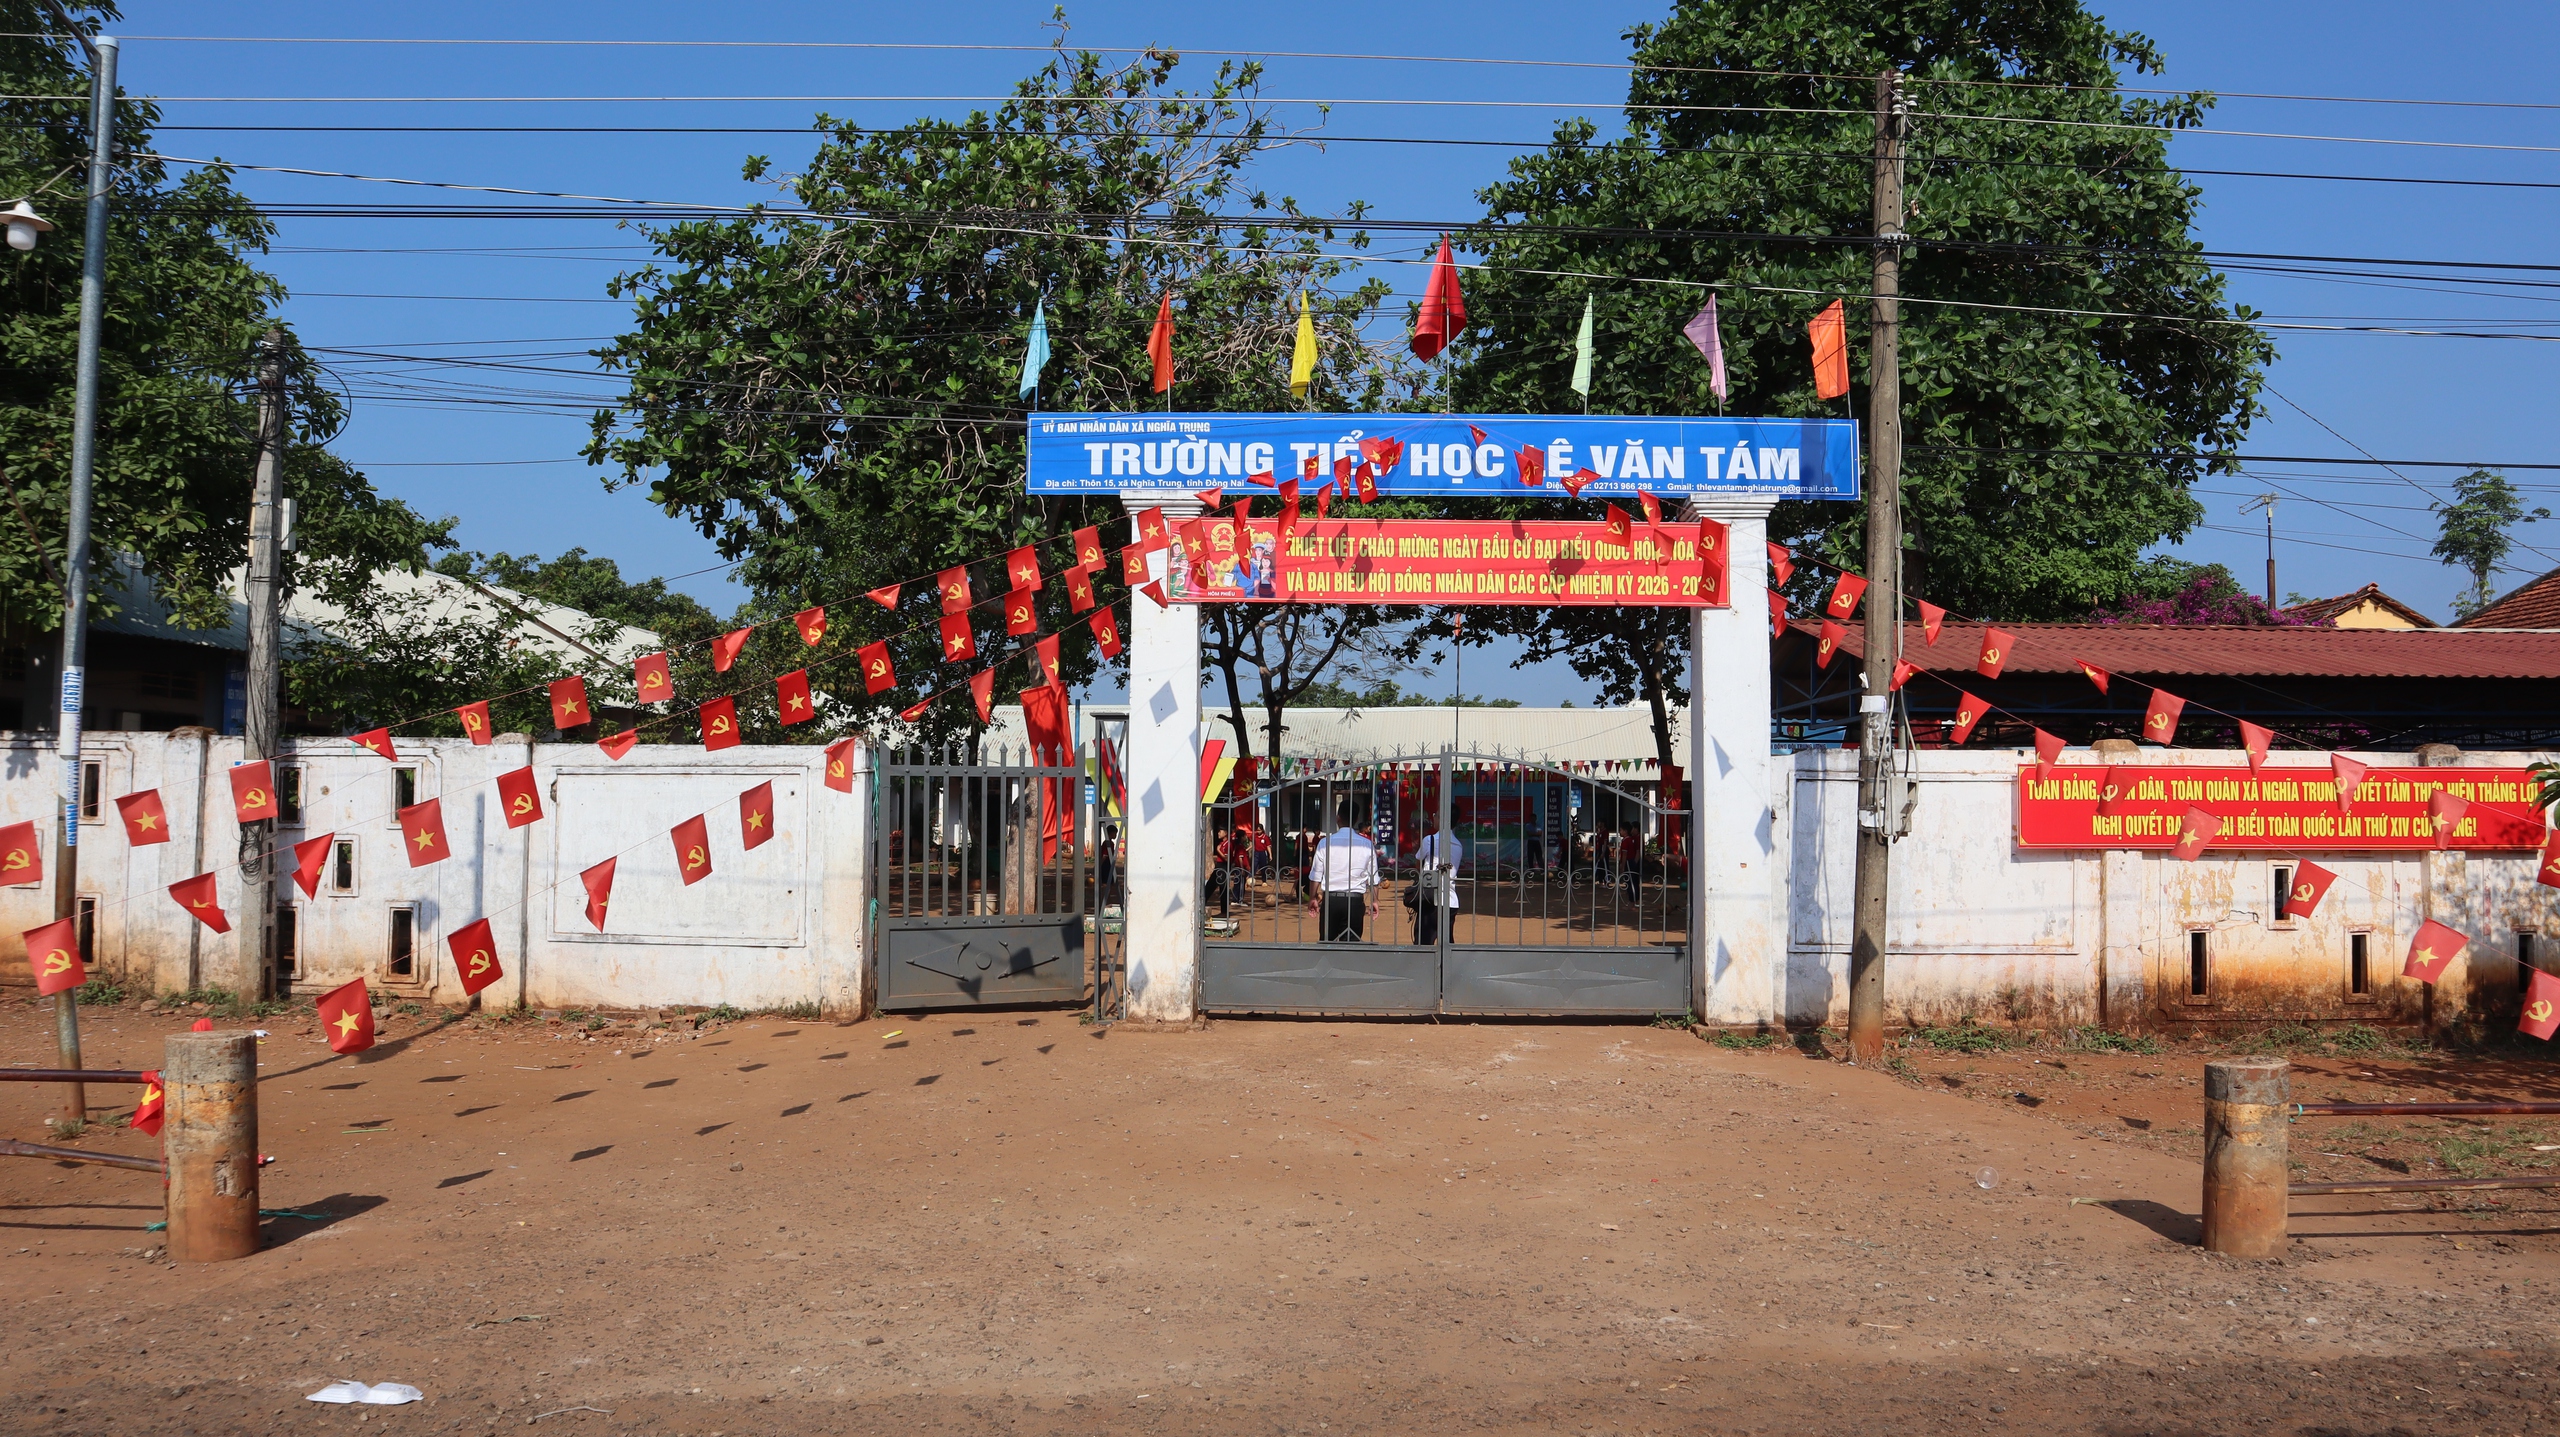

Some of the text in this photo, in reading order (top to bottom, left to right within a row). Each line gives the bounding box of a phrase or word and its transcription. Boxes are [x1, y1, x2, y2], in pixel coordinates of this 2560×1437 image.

[1057, 422, 1077, 432] BAN
[1080, 420, 1106, 432] NHÂN
[1109, 420, 1129, 432] DÂN
[1131, 420, 1144, 432] XÃ
[1147, 420, 1176, 432] NGHĨA
[1179, 422, 1210, 432] TRUNG
[1084, 429, 1799, 484] TRƯỜNG TIỂ HỌC Ê VĂN TÁM
[1045, 480, 1059, 488] Địa
[1062, 479, 1077, 487] chỉ:
[1080, 479, 1101, 487] Thôn
[1104, 480, 1116, 488] 15,
[1131, 480, 1155, 488] Nghĩa
[1158, 480, 1184, 488] Trung,
[1187, 479, 1203, 487] tỉnh
[1206, 478, 1228, 488] Đồng
[1594, 482, 1618, 490] 02713
[1696, 484, 1838, 493] thlevantamnghiatrung@gmail.com
[1328, 533, 1355, 561] LIỆT
[1359, 533, 1395, 557] CHÀO
[1399, 533, 1439, 558] MỪNG
[1443, 534, 1478, 558] NGÀY
[1482, 532, 1509, 559] BẦU
[1513, 532, 1532, 559] CỬ
[1534, 539, 1557, 564] ĐẠI
[1561, 532, 1591, 560] BIỂU
[1286, 567, 1304, 592] VÀ
[1307, 571, 1330, 596] ĐẠI
[1334, 564, 1365, 592] BIỂU
[1368, 568, 1391, 597] HỘI
[1395, 566, 1432, 593] ĐỒNG
[1435, 569, 1473, 593] NHÂN
[1477, 569, 1505, 594] DÂN
[1508, 569, 1535, 594] CÁC
[1539, 567, 1566, 594] CẤP
[1569, 570, 1613, 599] NHIỆM
[1617, 571, 1634, 595] KỲ
[1637, 575, 1669, 596] 2026
[2063, 773, 2100, 803] ĐẢNG,
[2139, 776, 2168, 803] DÂN,
[2171, 776, 2203, 801] TOÀN
[2206, 776, 2239, 803] QUÂN
[2242, 778, 2259, 801] XÃ
[2262, 777, 2300, 802] NGHĨA
[2302, 781, 2338, 802] TRUN
[2349, 775, 2382, 804] UYẾT
[2384, 778, 2411, 802] TÂM
[2478, 775, 2517, 803] THẮNG
[2092, 815, 2122, 840] NGHỊ
[2126, 809, 2163, 838] QUYẾT
[2237, 808, 2265, 837] BIỂU
[2268, 812, 2300, 837] TOÀN
[2302, 809, 2335, 839] QUỐC
[2338, 810, 2361, 837] LẦN
[2364, 812, 2388, 837] THỨ
[2390, 817, 2410, 837] XIV
